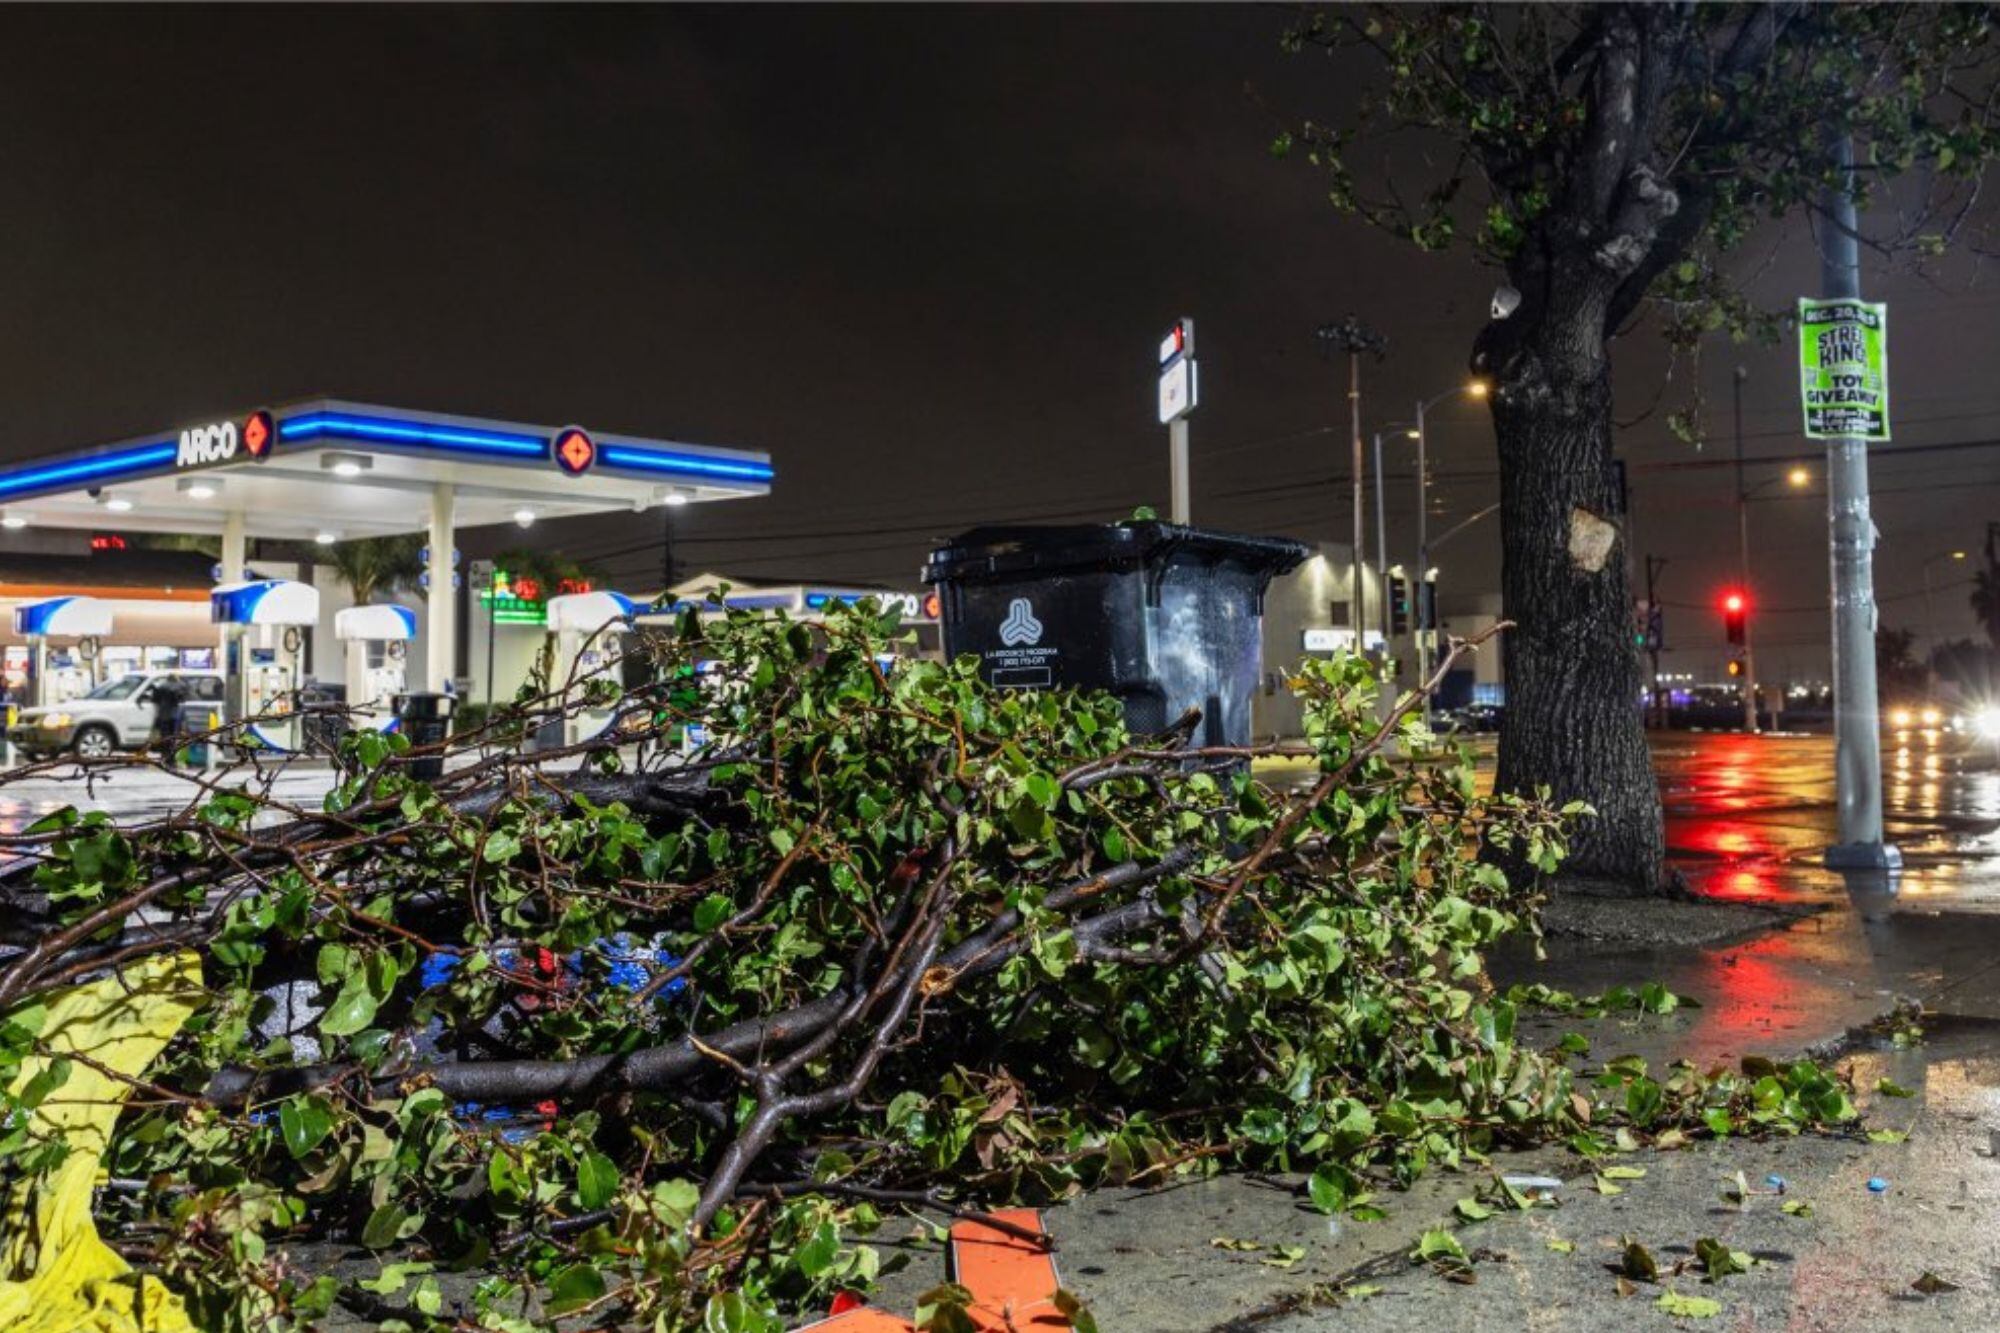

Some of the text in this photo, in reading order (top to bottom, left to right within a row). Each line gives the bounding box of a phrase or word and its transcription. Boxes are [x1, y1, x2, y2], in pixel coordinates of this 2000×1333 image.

[1820, 343, 1868, 369] KING
[1831, 374, 1863, 388] TOY
[177, 421, 237, 467] ARCO
